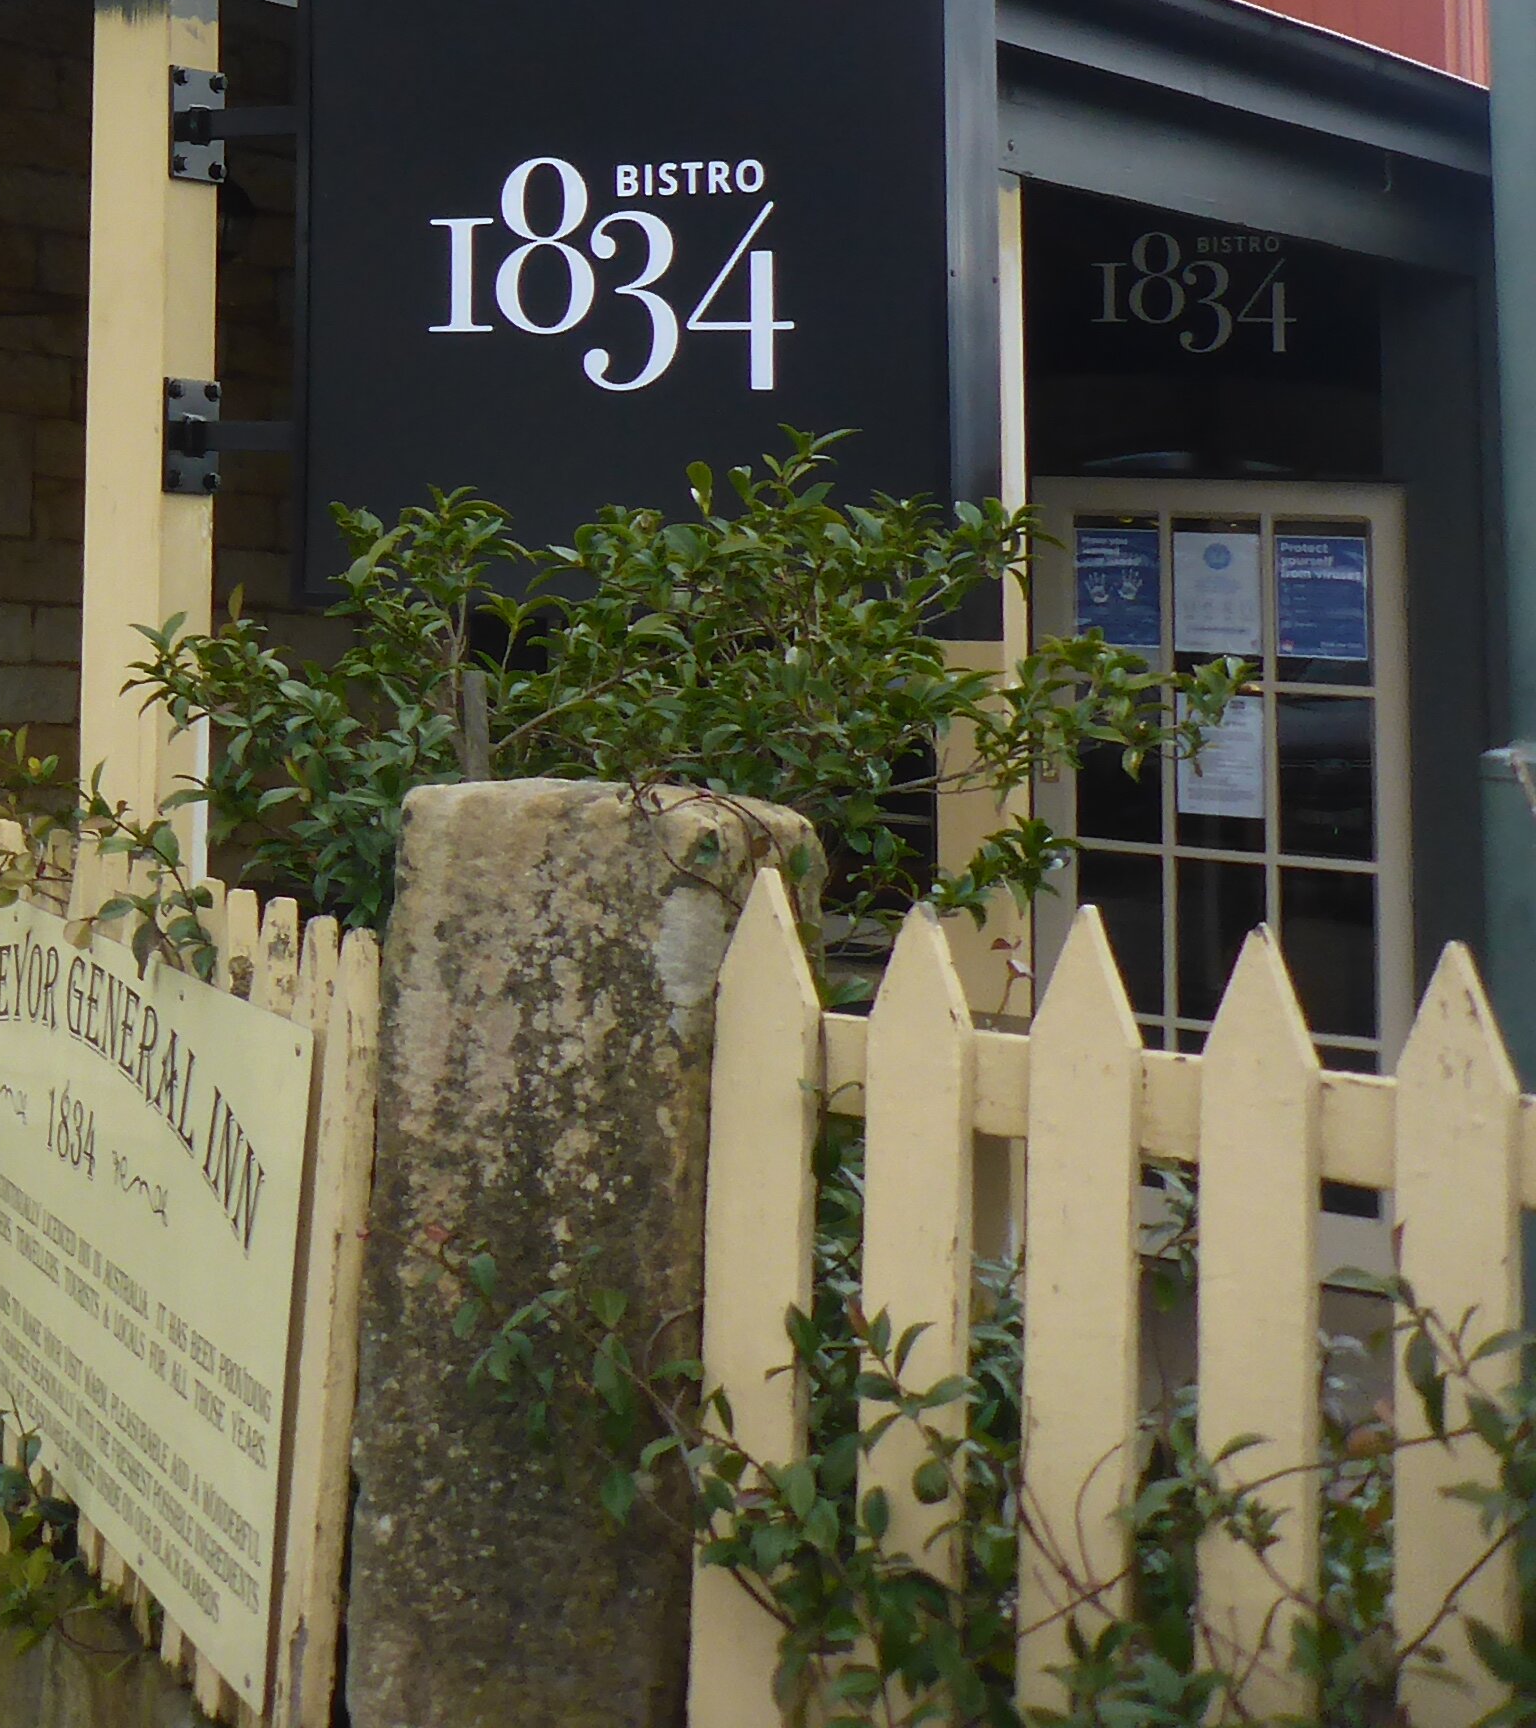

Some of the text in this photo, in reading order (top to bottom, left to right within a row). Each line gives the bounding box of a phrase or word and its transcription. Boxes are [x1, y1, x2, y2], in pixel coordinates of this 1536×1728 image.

[615, 158, 766, 198] BISTRO
[428, 156, 796, 392] 1834
[1090, 231, 1298, 355] 1834
[1196, 234, 1282, 255] BISTRO
[1280, 542, 1329, 554] Protect
[46, 1078, 96, 1182] 1834
[66, 955, 195, 1160] GENERAL
[202, 1085, 266, 1260] INN
[112, 1307, 146, 1363] LOCALS
[148, 1338, 166, 1381] FOR
[169, 1356, 189, 1401] ALL
[193, 1376, 225, 1433] THOSE
[156, 1299, 166, 1335] IT
[168, 1309, 187, 1353] HAS
[190, 1327, 216, 1378] BEEN
[218, 1349, 272, 1425] PROVIDING
[170, 1448, 190, 1497] AND
[190, 1468, 200, 1507] A
[201, 1479, 262, 1569] WONDERFUL
[181, 1555, 220, 1627] BOARDS
[194, 1519, 260, 1617] INGREDIENTS
